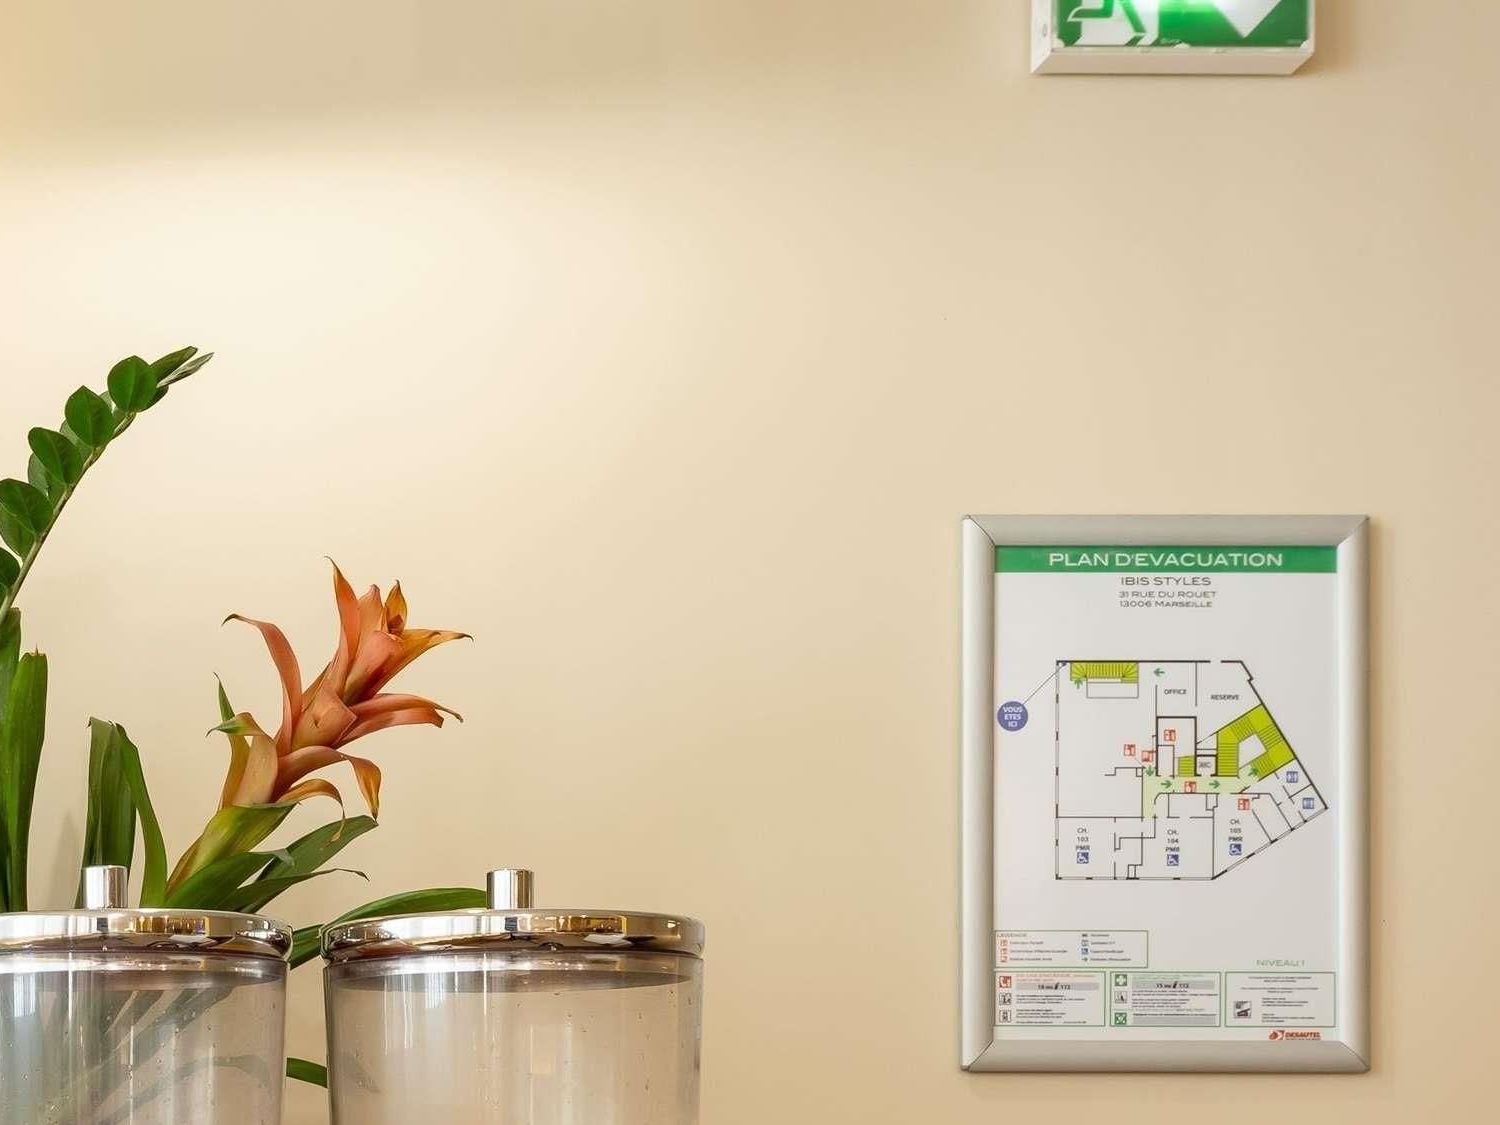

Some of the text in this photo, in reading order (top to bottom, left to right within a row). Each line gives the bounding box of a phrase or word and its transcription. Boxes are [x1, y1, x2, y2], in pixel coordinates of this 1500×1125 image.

[1049, 553, 1284, 567] PLAN D'EVACUATION
[1121, 576, 1212, 586] IBIS STYLES
[1120, 600, 1152, 608] 13006
